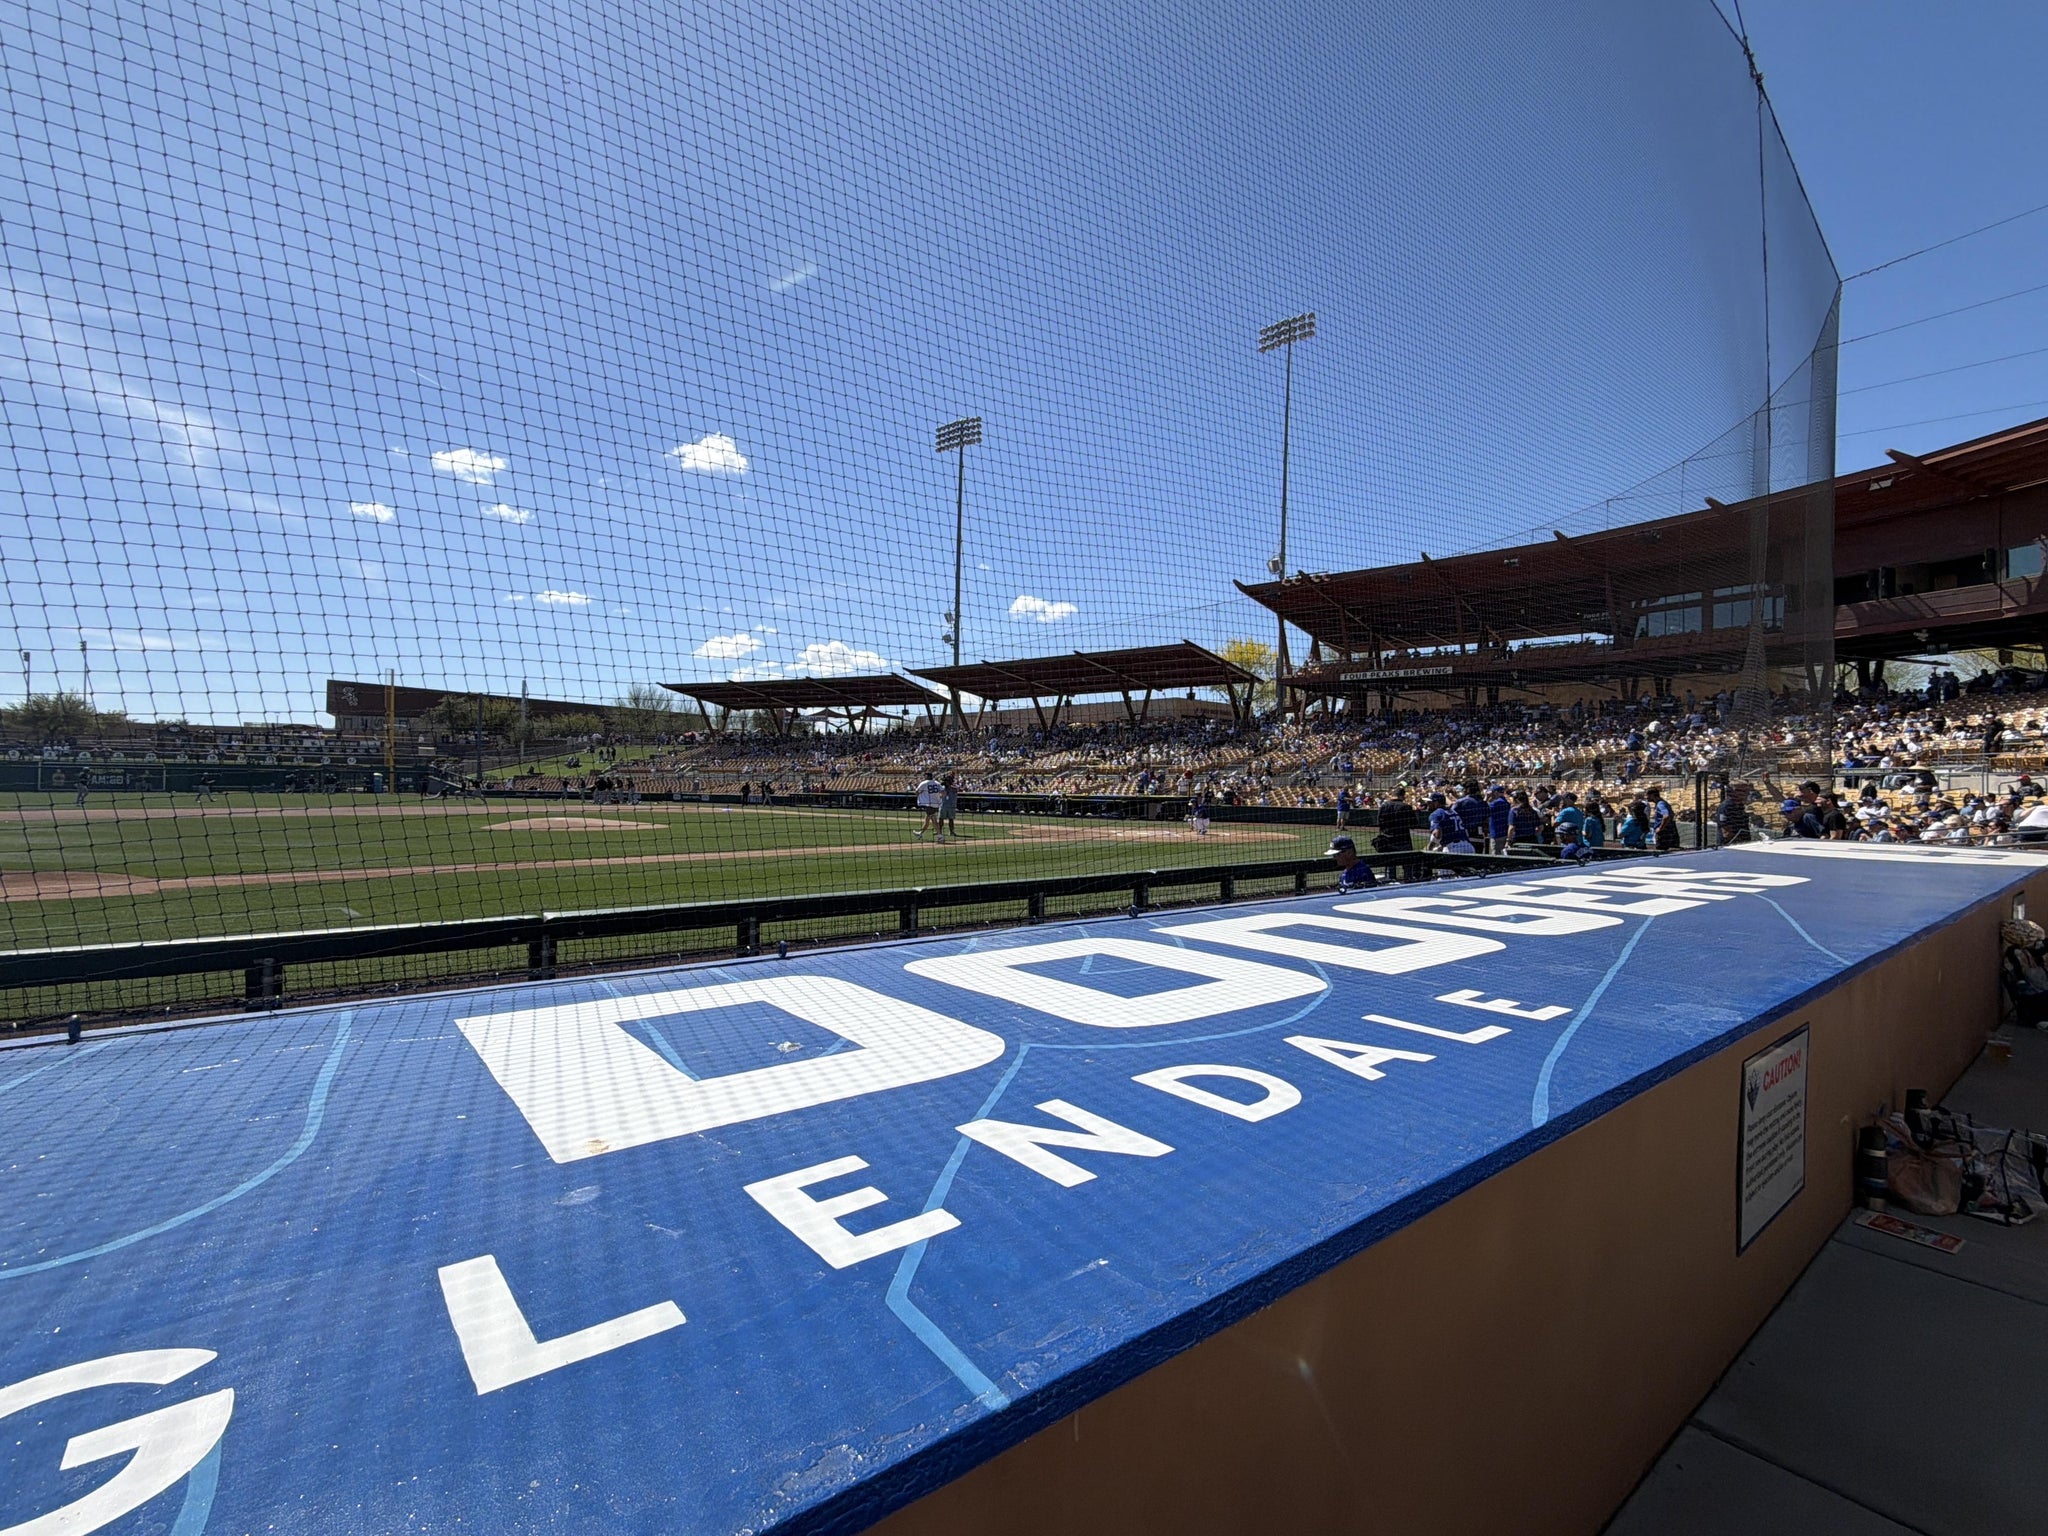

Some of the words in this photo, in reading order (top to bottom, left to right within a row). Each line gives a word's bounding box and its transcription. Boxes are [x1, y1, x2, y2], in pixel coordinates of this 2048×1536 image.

[1370, 671, 1400, 679] PEAKS
[1402, 667, 1448, 677] BREWING
[1450, 816, 1465, 831] 72
[454, 865, 1812, 1164] DODGERS
[1762, 1049, 1802, 1091] CAUTION!
